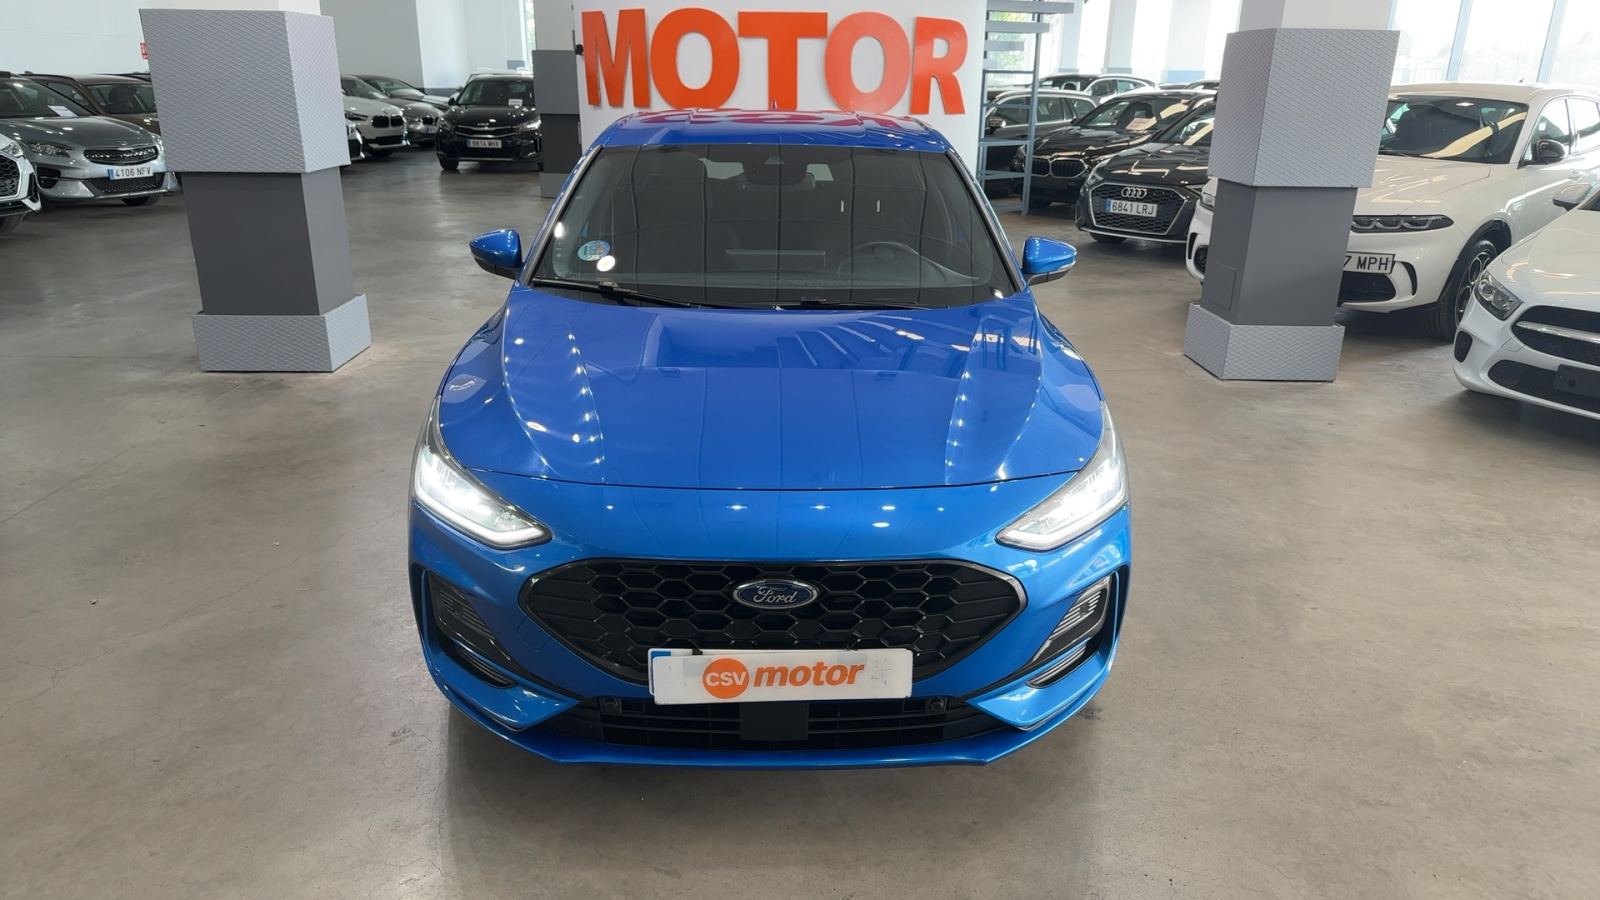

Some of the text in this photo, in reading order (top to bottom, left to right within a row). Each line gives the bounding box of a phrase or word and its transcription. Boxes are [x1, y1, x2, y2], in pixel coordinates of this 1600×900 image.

[582, 7, 968, 115] MOTOR
[115, 167, 151, 177] 4106 NFV
[1112, 201, 1154, 215] 6841 LRJ
[1356, 255, 1389, 271] MPH
[753, 586, 798, 603] Ford
[753, 661, 865, 687] motor
